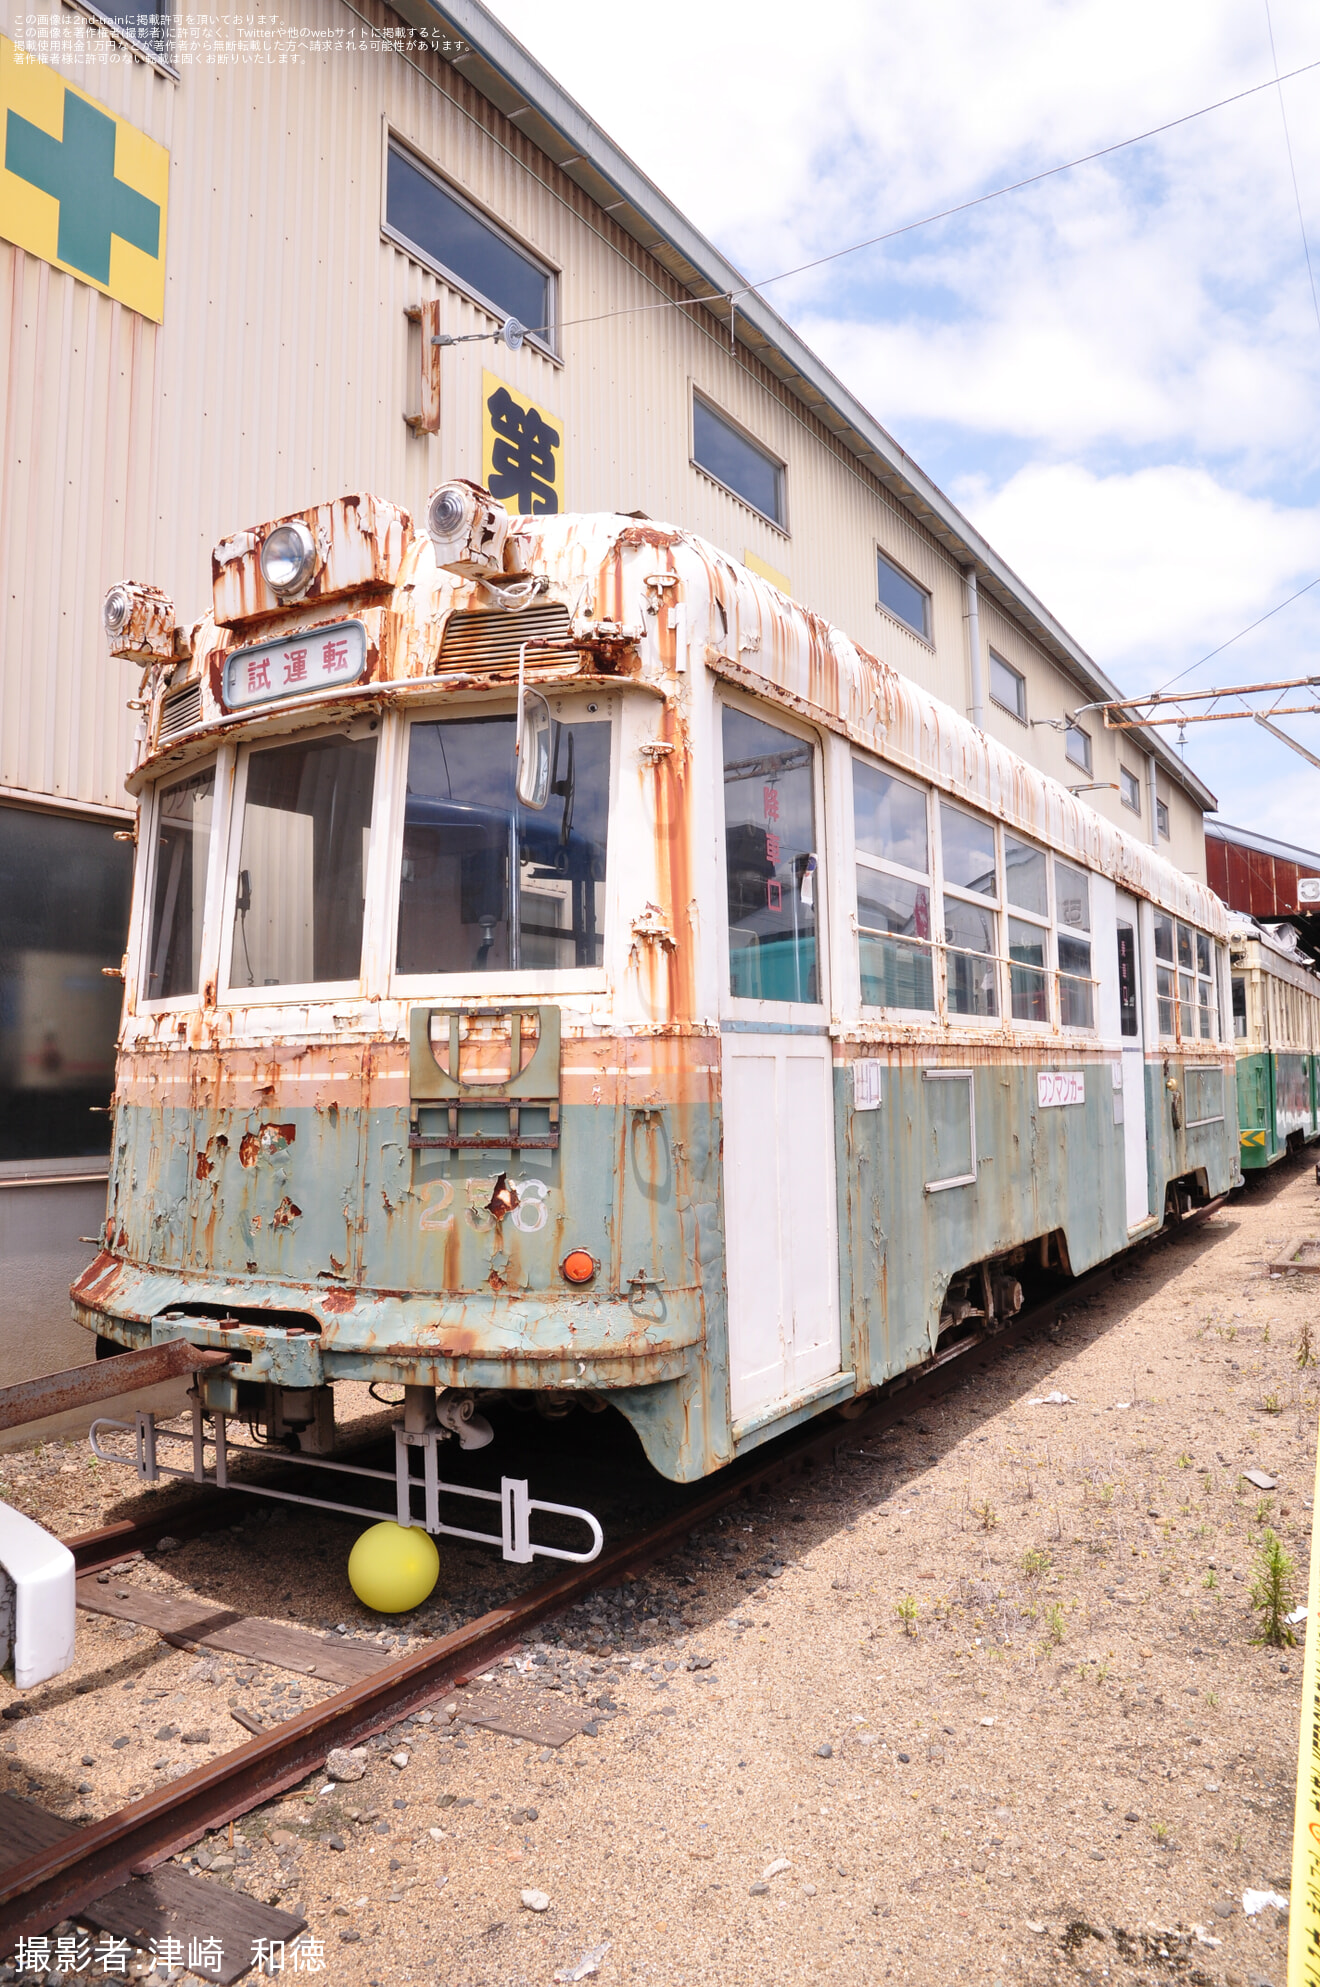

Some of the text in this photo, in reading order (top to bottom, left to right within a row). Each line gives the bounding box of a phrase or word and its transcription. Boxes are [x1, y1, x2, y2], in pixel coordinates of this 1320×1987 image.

[247, 639, 349, 694] 試運転
[763, 786, 782, 912] 降車口
[1039, 1075, 1083, 1103] ワンマンカー
[419, 1178, 549, 1233] 256
